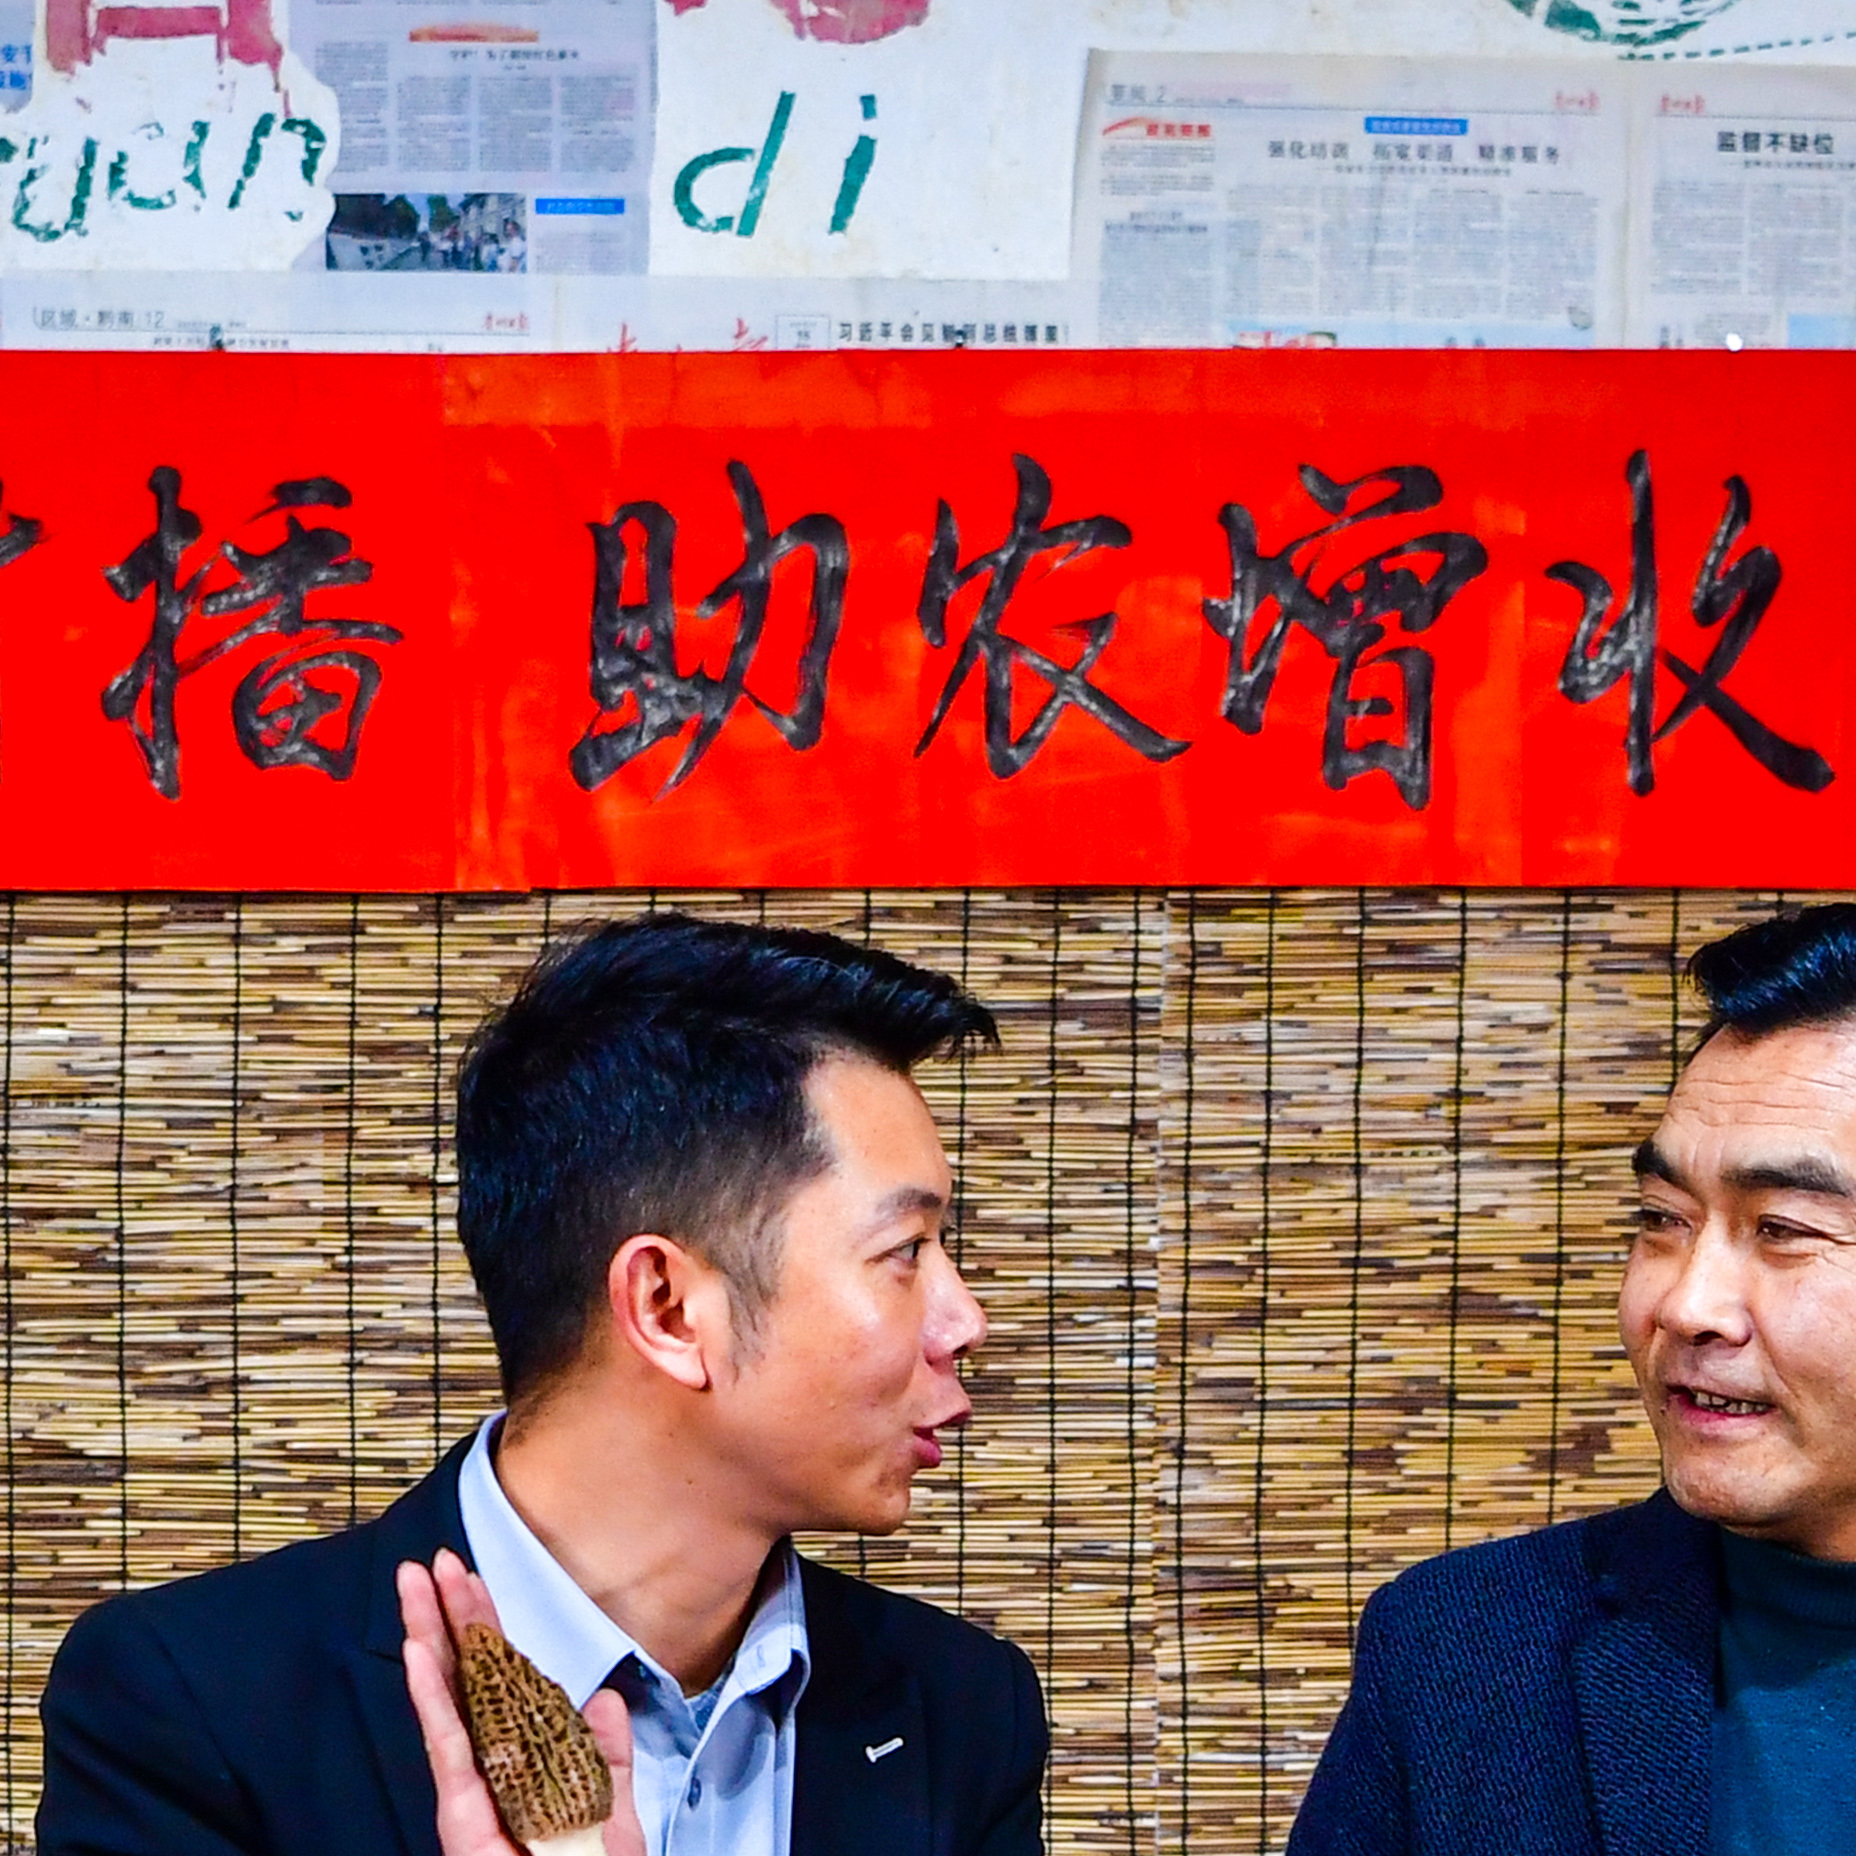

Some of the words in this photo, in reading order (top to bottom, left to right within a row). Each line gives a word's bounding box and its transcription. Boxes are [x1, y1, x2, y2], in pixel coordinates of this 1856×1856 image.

[673, 91, 878, 238] di
[569, 448, 1838, 812] 助农增收
